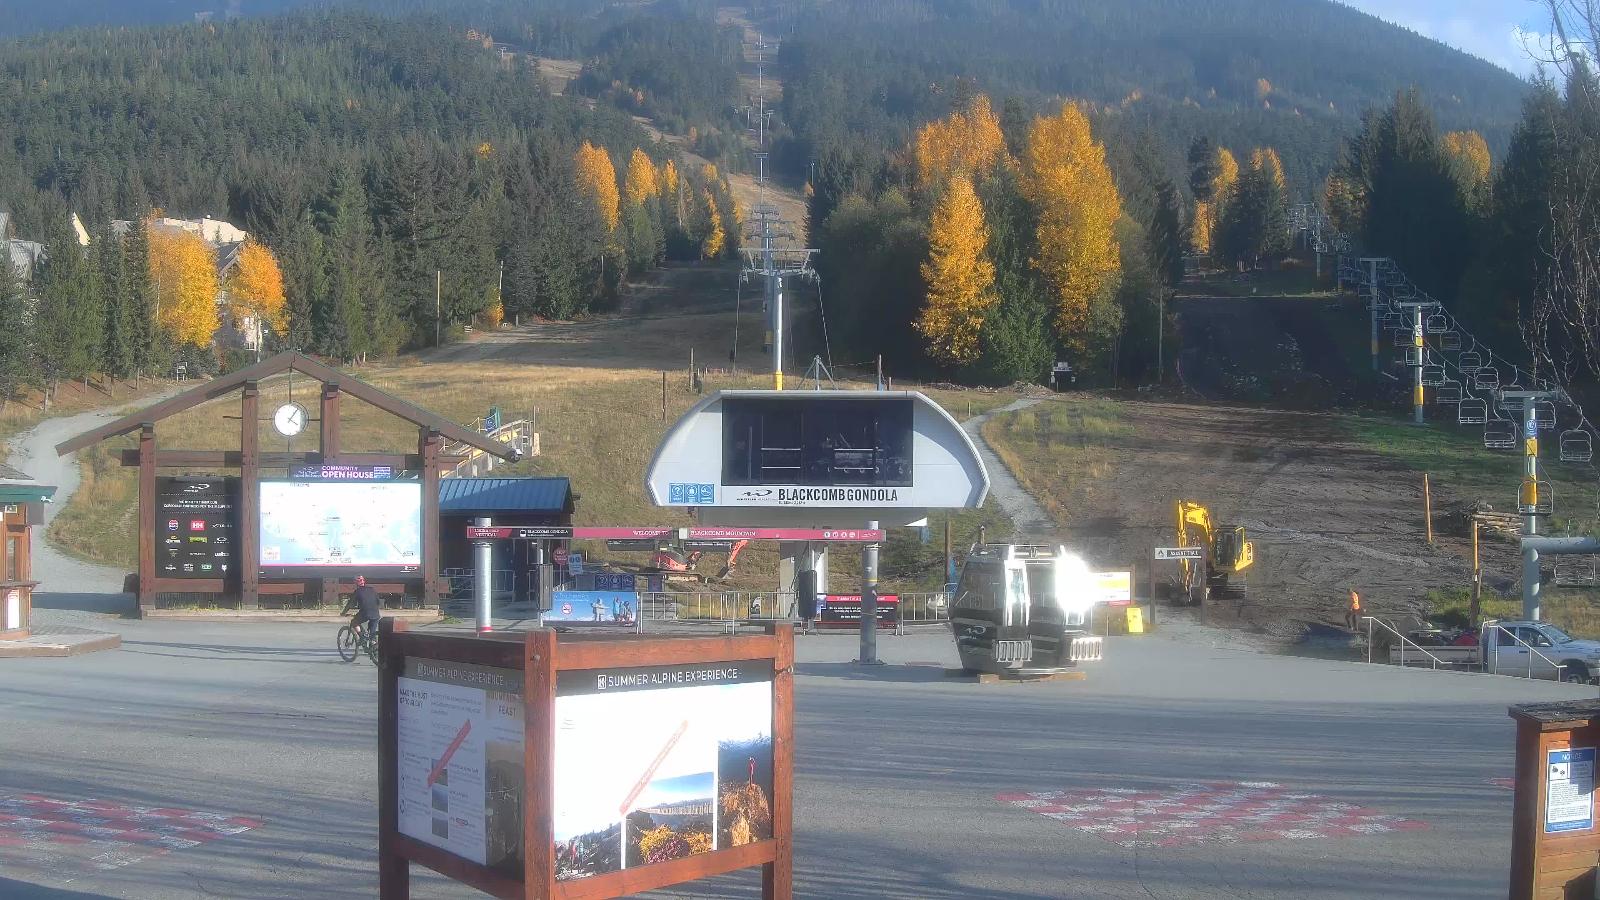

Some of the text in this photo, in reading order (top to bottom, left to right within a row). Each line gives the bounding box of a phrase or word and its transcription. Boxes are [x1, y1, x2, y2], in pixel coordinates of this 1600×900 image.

[321, 470, 346, 479] OPEN
[346, 471, 374, 479] HOUSE
[778, 488, 898, 501] BLACKCOMB GONDOLA
[608, 668, 738, 687] SUMMER ALPINE EXPERIENCE
